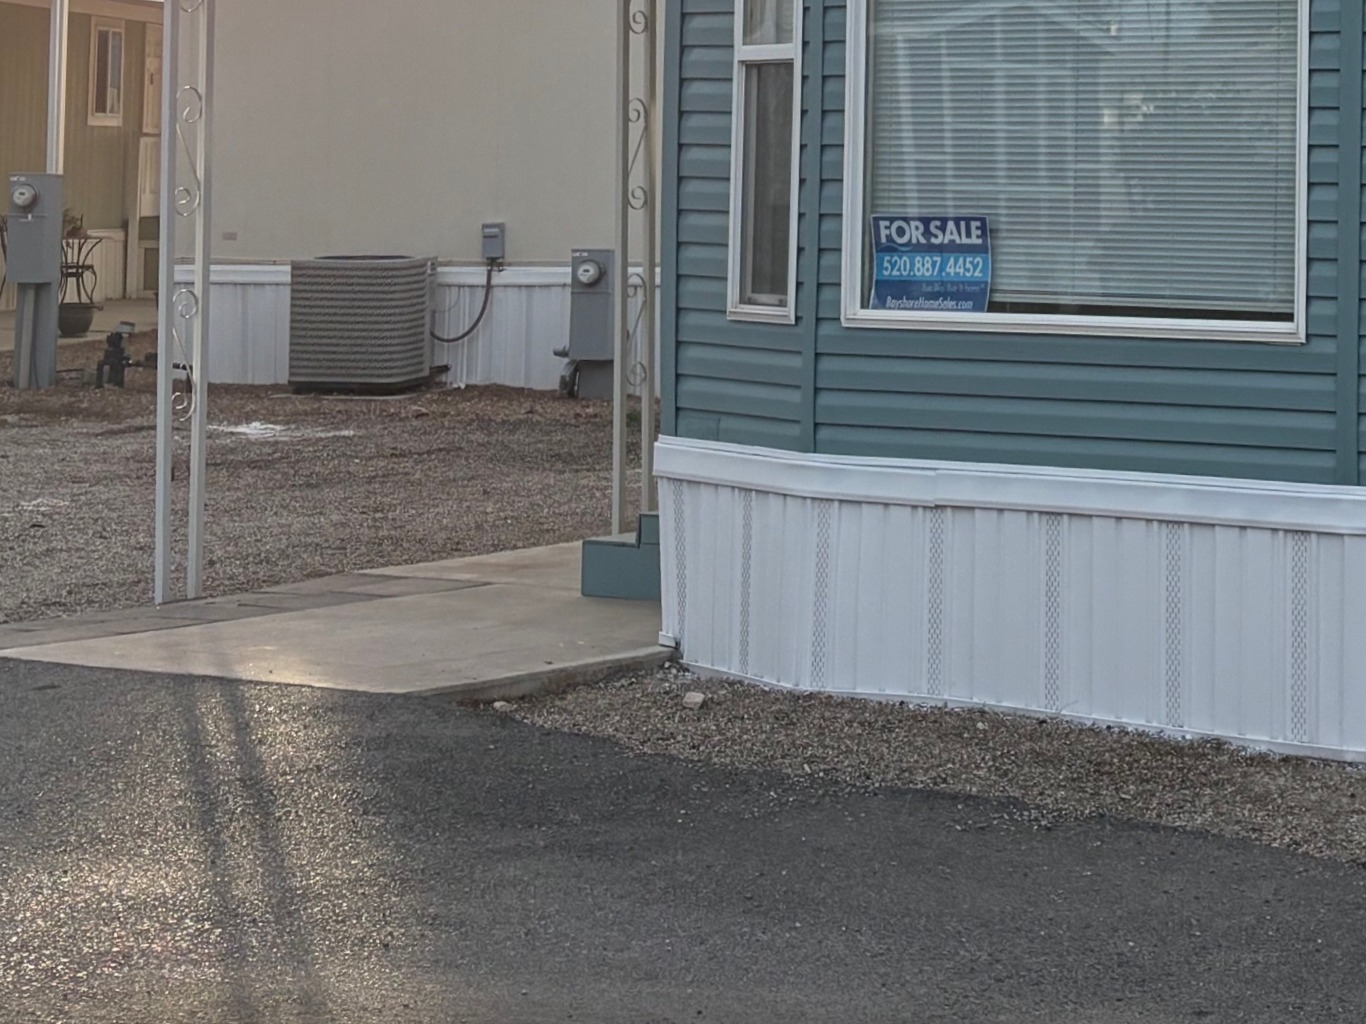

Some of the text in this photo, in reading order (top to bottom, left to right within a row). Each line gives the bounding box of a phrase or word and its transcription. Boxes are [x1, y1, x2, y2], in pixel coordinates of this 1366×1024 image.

[878, 219, 983, 245] FOR SALE
[882, 256, 983, 277] 520.887.4452
